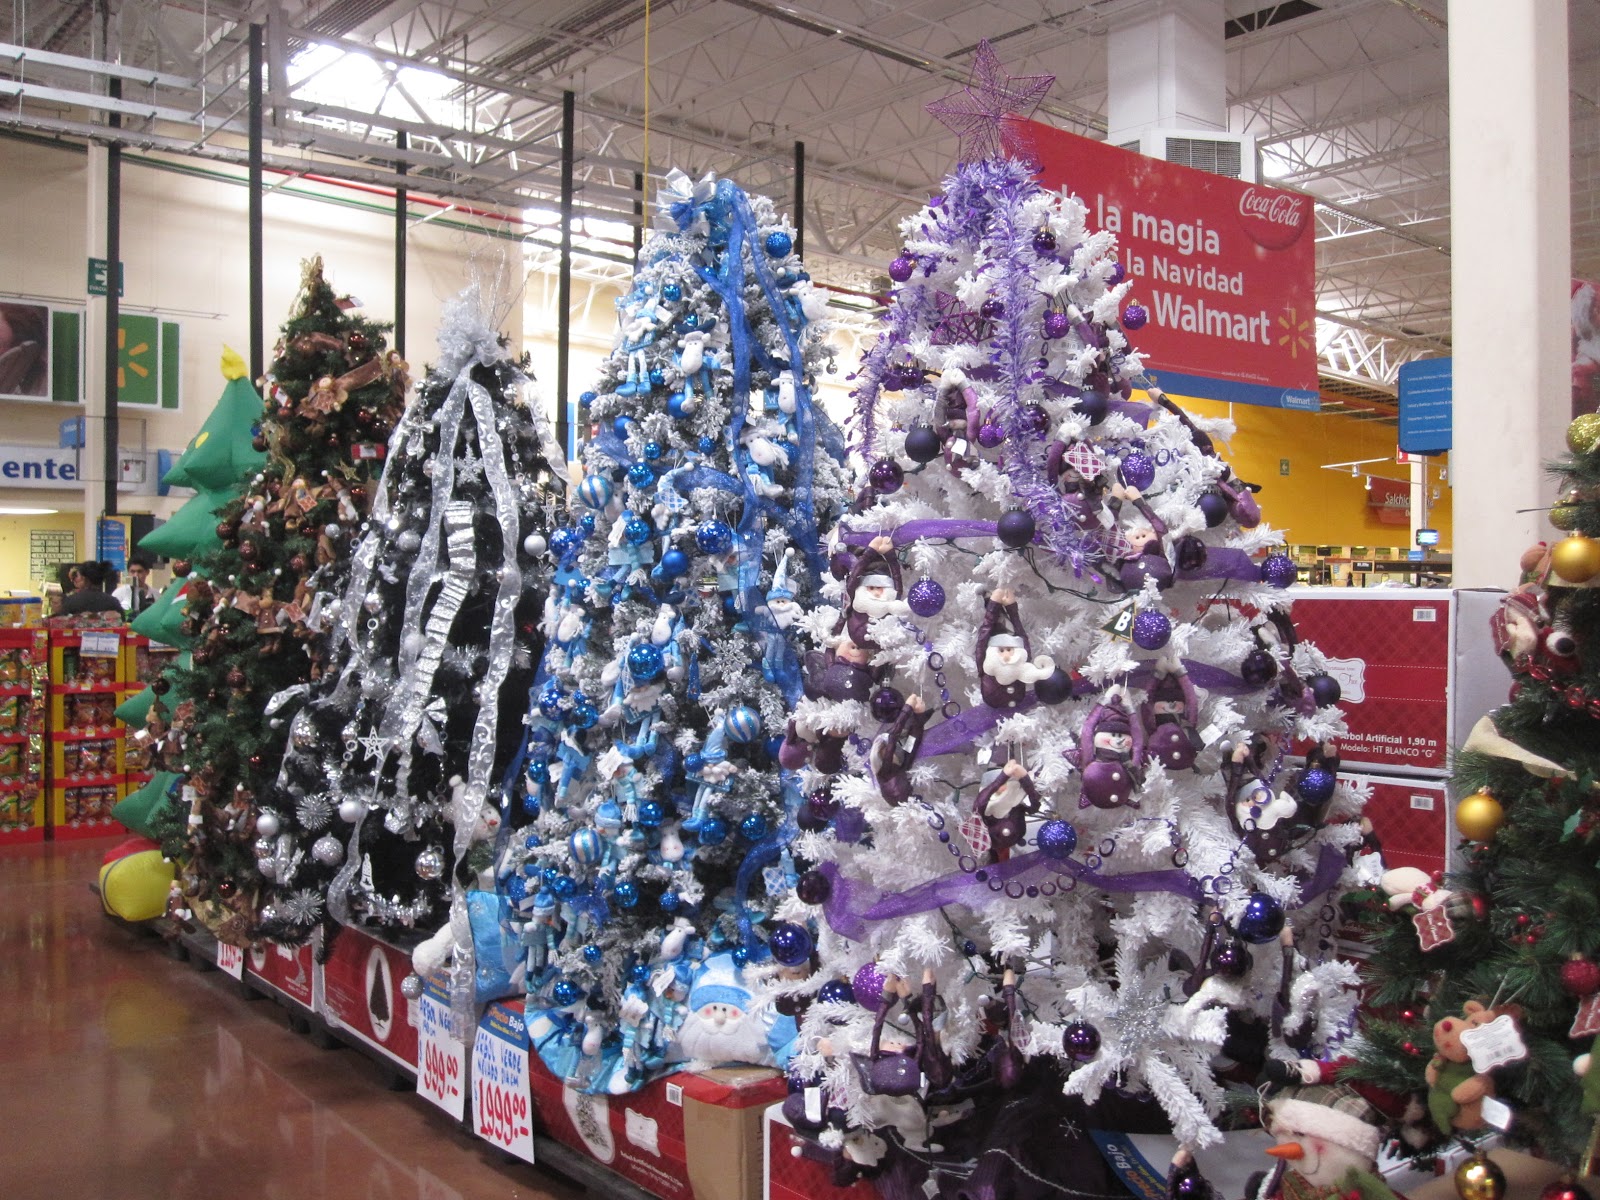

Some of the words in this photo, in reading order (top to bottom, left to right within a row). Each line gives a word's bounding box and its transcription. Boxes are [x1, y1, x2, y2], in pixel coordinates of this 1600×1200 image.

[1239, 187, 1303, 227] Coca-Cola
[1097, 193, 1122, 233] la
[1132, 211, 1220, 256] magia
[1126, 248, 1145, 277] la
[1152, 255, 1243, 296] Navidad
[1152, 289, 1271, 346] Walmart
[1114, 611, 1132, 632] B
[1340, 743, 1371, 753] Modelo:
[1372, 745, 1384, 753] HT
[1385, 746, 1420, 757] BLANCO
[1365, 733, 1402, 745] Artificial
[1408, 737, 1426, 746] 1,90
[1428, 739, 1437, 747] m
[508, 1015, 525, 1033] Bajo
[1106, 1143, 1132, 1169] Bajo
